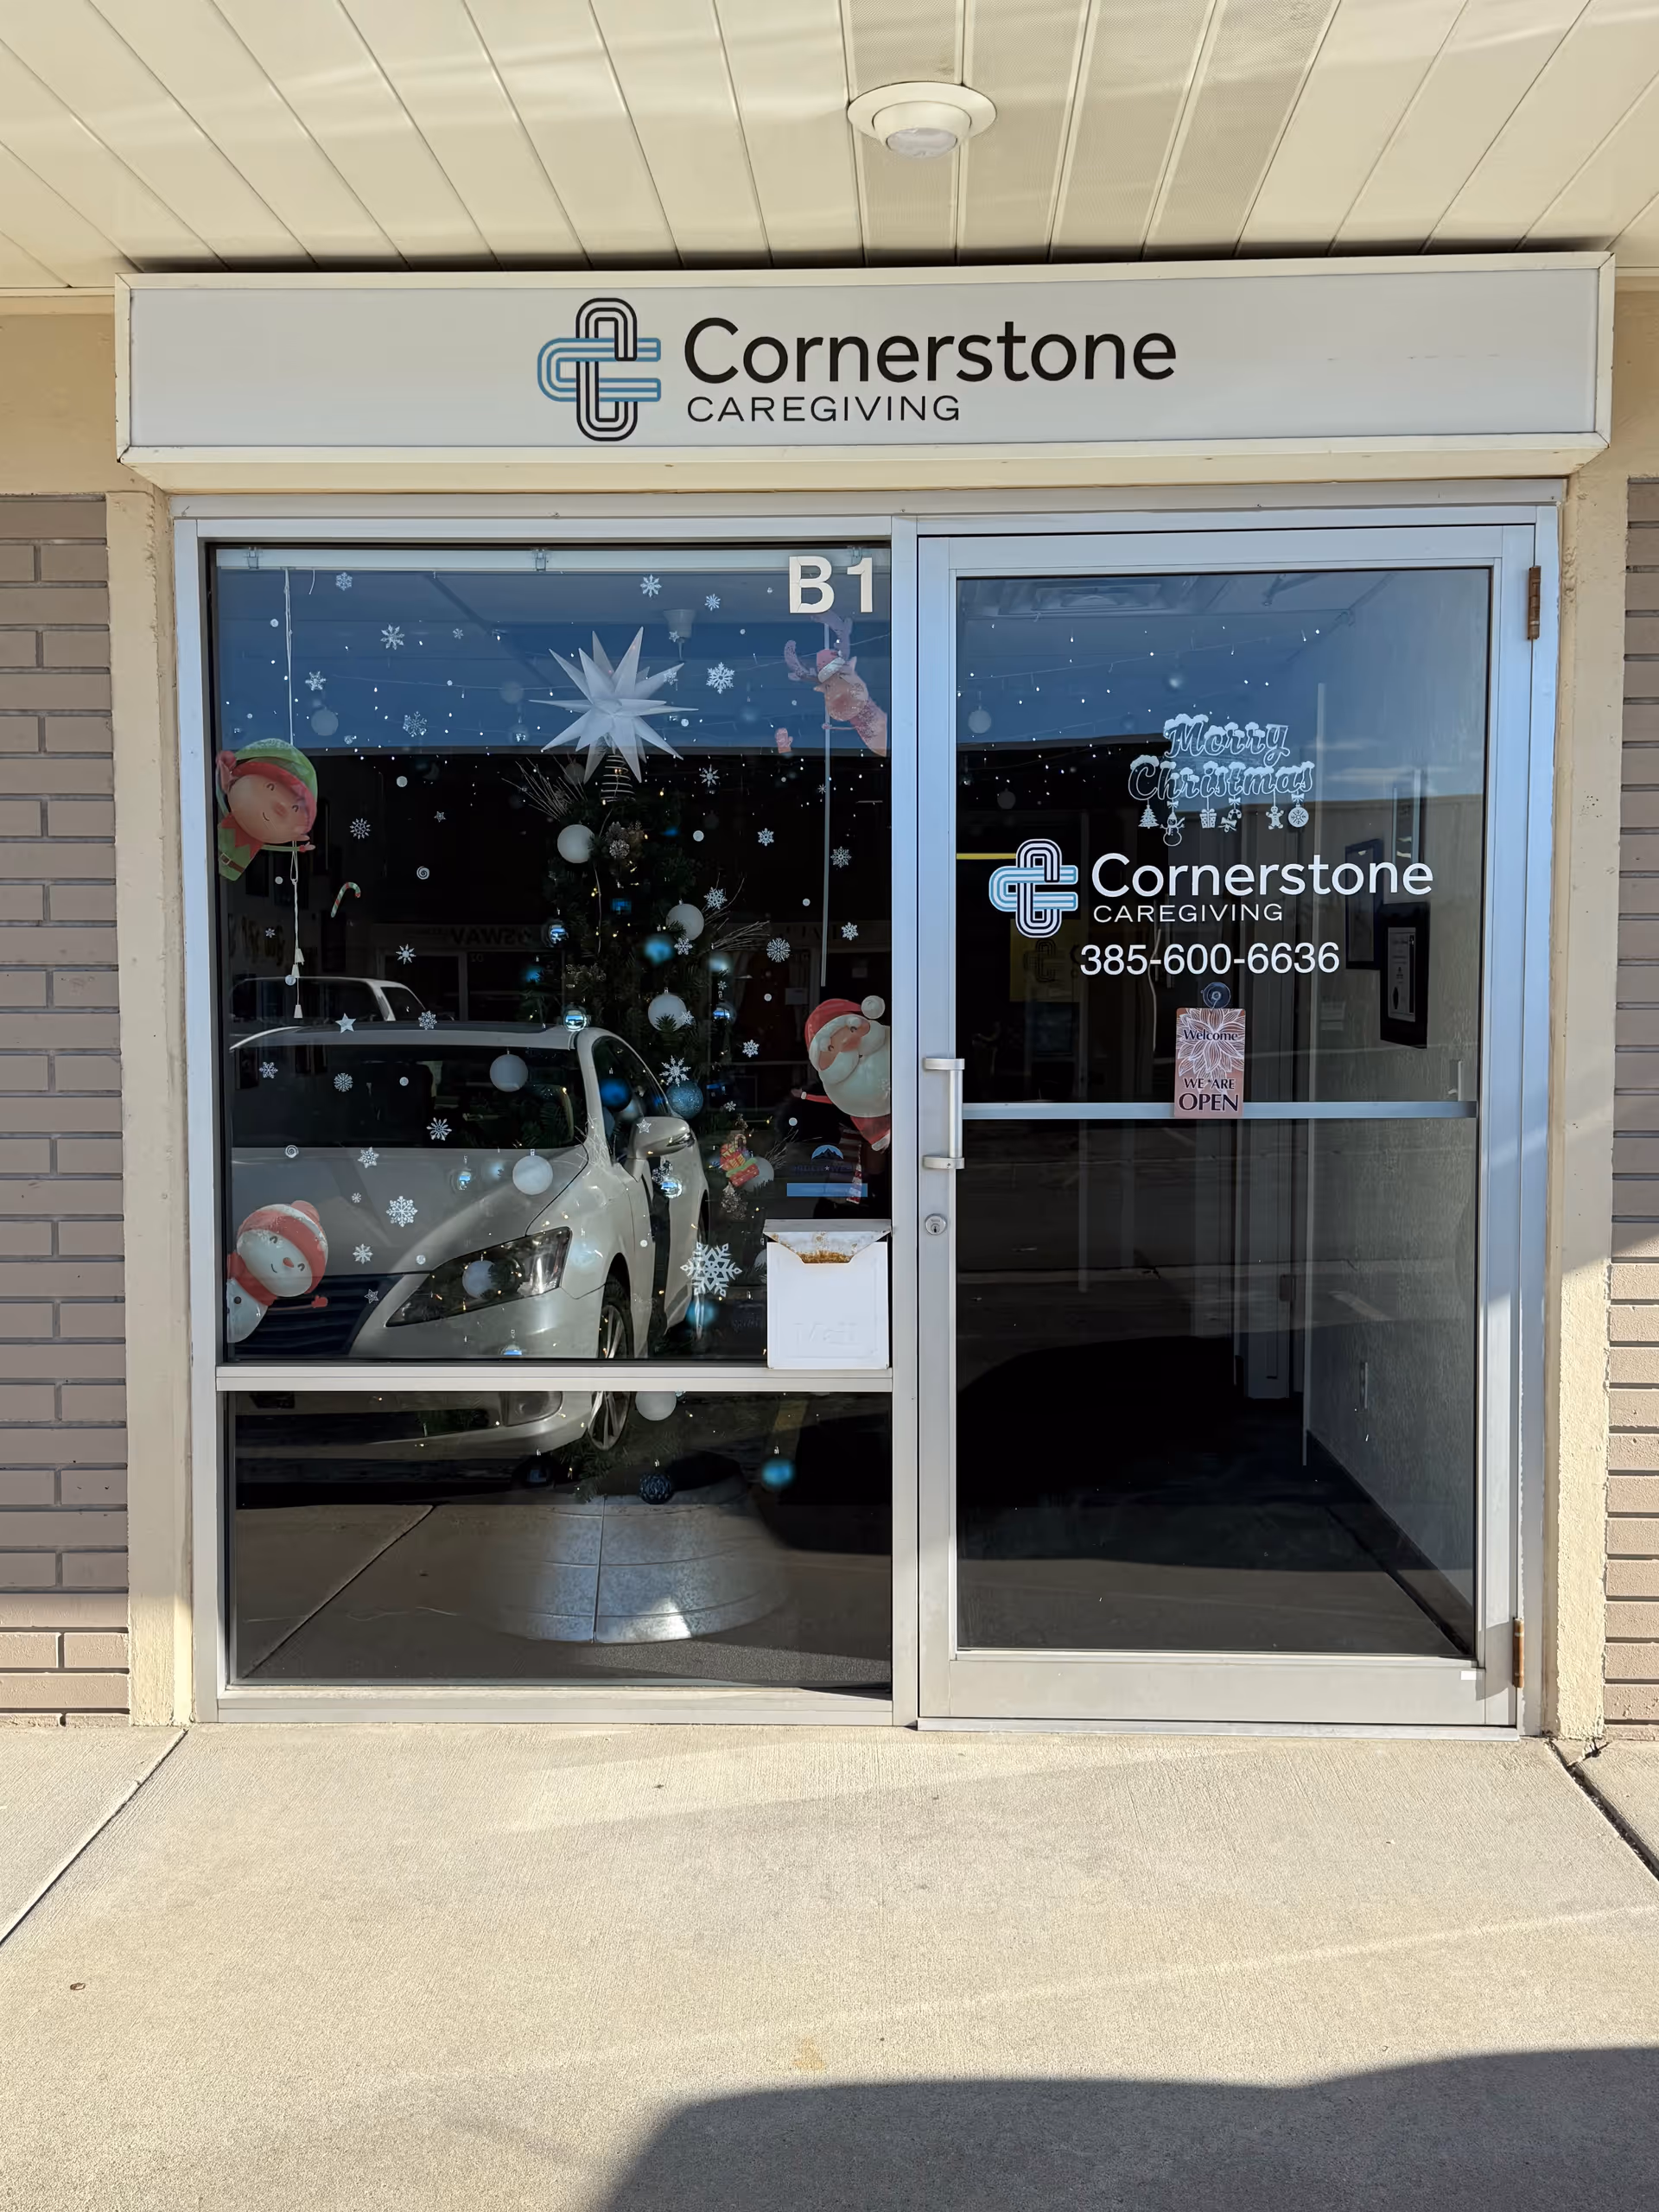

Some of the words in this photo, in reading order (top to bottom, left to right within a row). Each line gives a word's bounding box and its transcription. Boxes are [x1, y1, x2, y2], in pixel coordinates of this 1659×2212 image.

[684, 316, 1177, 385] Cornerstone
[687, 395, 960, 423] CAREGIVING
[788, 555, 874, 614] B1
[1164, 714, 1291, 767] Merry
[1128, 754, 1315, 800] Christmas
[1091, 853, 1434, 898] Cornerstone
[1093, 903, 1283, 923] CAREGIVING
[1080, 942, 1340, 976] 385-600-6636
[1184, 1029, 1238, 1041] Welcome
[1184, 1078, 1204, 1089] WE
[1211, 1078, 1235, 1089] ARE
[1179, 1092, 1239, 1112] OPEN
